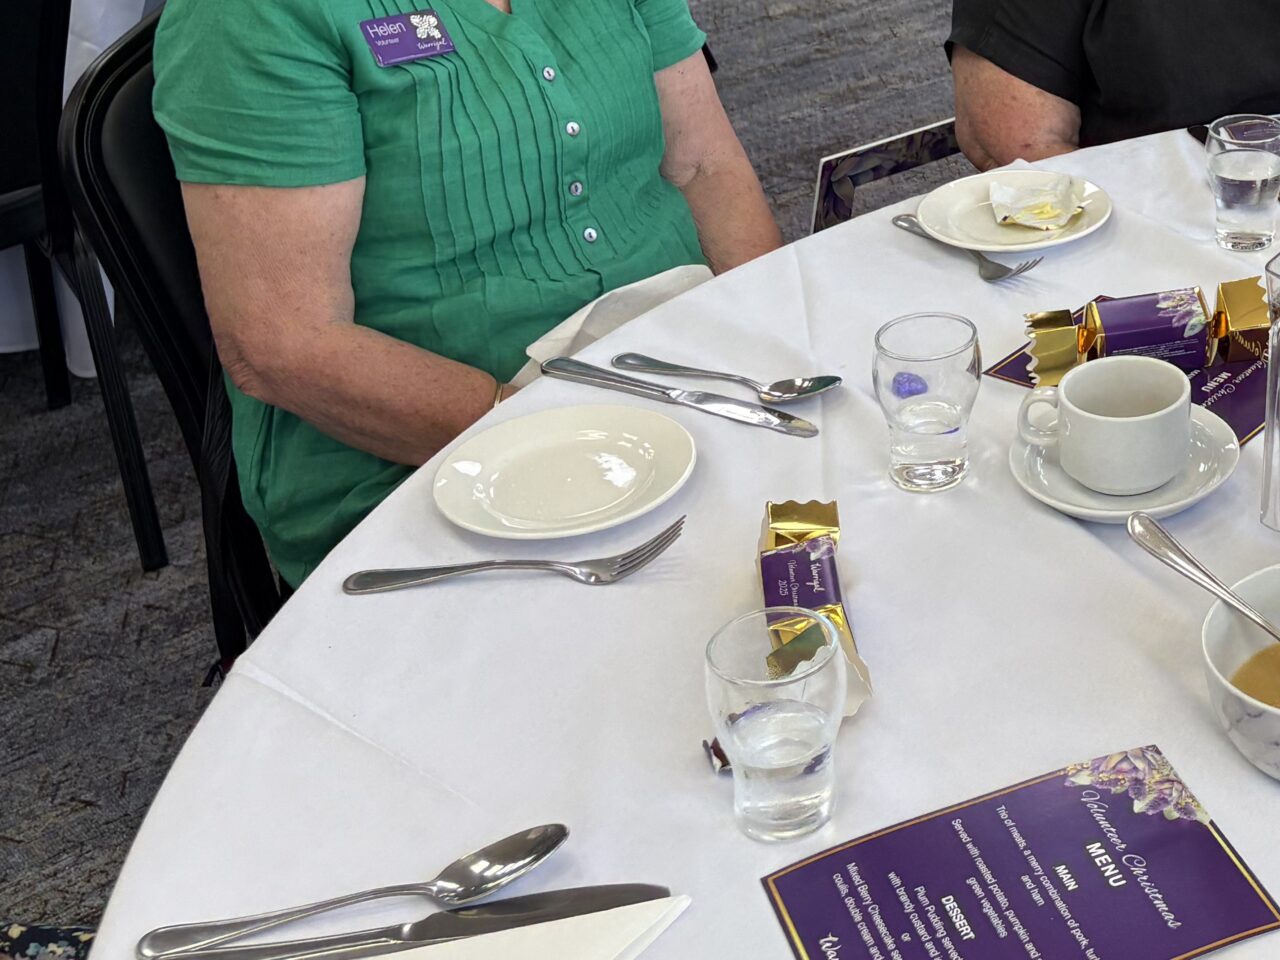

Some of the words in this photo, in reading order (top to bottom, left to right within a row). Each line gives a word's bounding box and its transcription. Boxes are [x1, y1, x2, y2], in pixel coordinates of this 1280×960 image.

[366, 22, 406, 38] Helen
[1201, 371, 1232, 392] MENU
[778, 579, 788, 596] 2025
[996, 804, 1008, 819] Trio
[1004, 818, 1015, 828] of
[1027, 854, 1044, 876] merry
[1040, 875, 1072, 920] combination
[1067, 919, 1080, 929] of
[1055, 864, 1079, 891] MAIN
[1081, 790, 1127, 851] Volunteer
[1122, 854, 1182, 929] Christmas
[1086, 842, 1127, 887] MENU
[846, 862, 865, 886] Mixed
[857, 884, 874, 905] Berry
[868, 904, 896, 950] Cheesecake
[914, 885, 930, 906] Plum
[925, 905, 947, 938] Pudding
[952, 818, 972, 843] Served
[966, 841, 980, 858] with
[974, 857, 998, 884] roasted
[1004, 909, 1030, 943] pumpkin
[1024, 942, 1041, 959] and
[966, 877, 985, 899] green
[981, 897, 1008, 938] vegetables
[1021, 874, 1036, 889] and
[1031, 887, 1045, 906] ham
[844, 896, 864, 922] double
[857, 921, 875, 947] cream
[888, 871, 902, 888] with
[896, 886, 915, 913] brandy
[909, 912, 932, 942] custard
[924, 941, 941, 958] and
[901, 932, 911, 942] or
[941, 895, 976, 940] DESSERT
